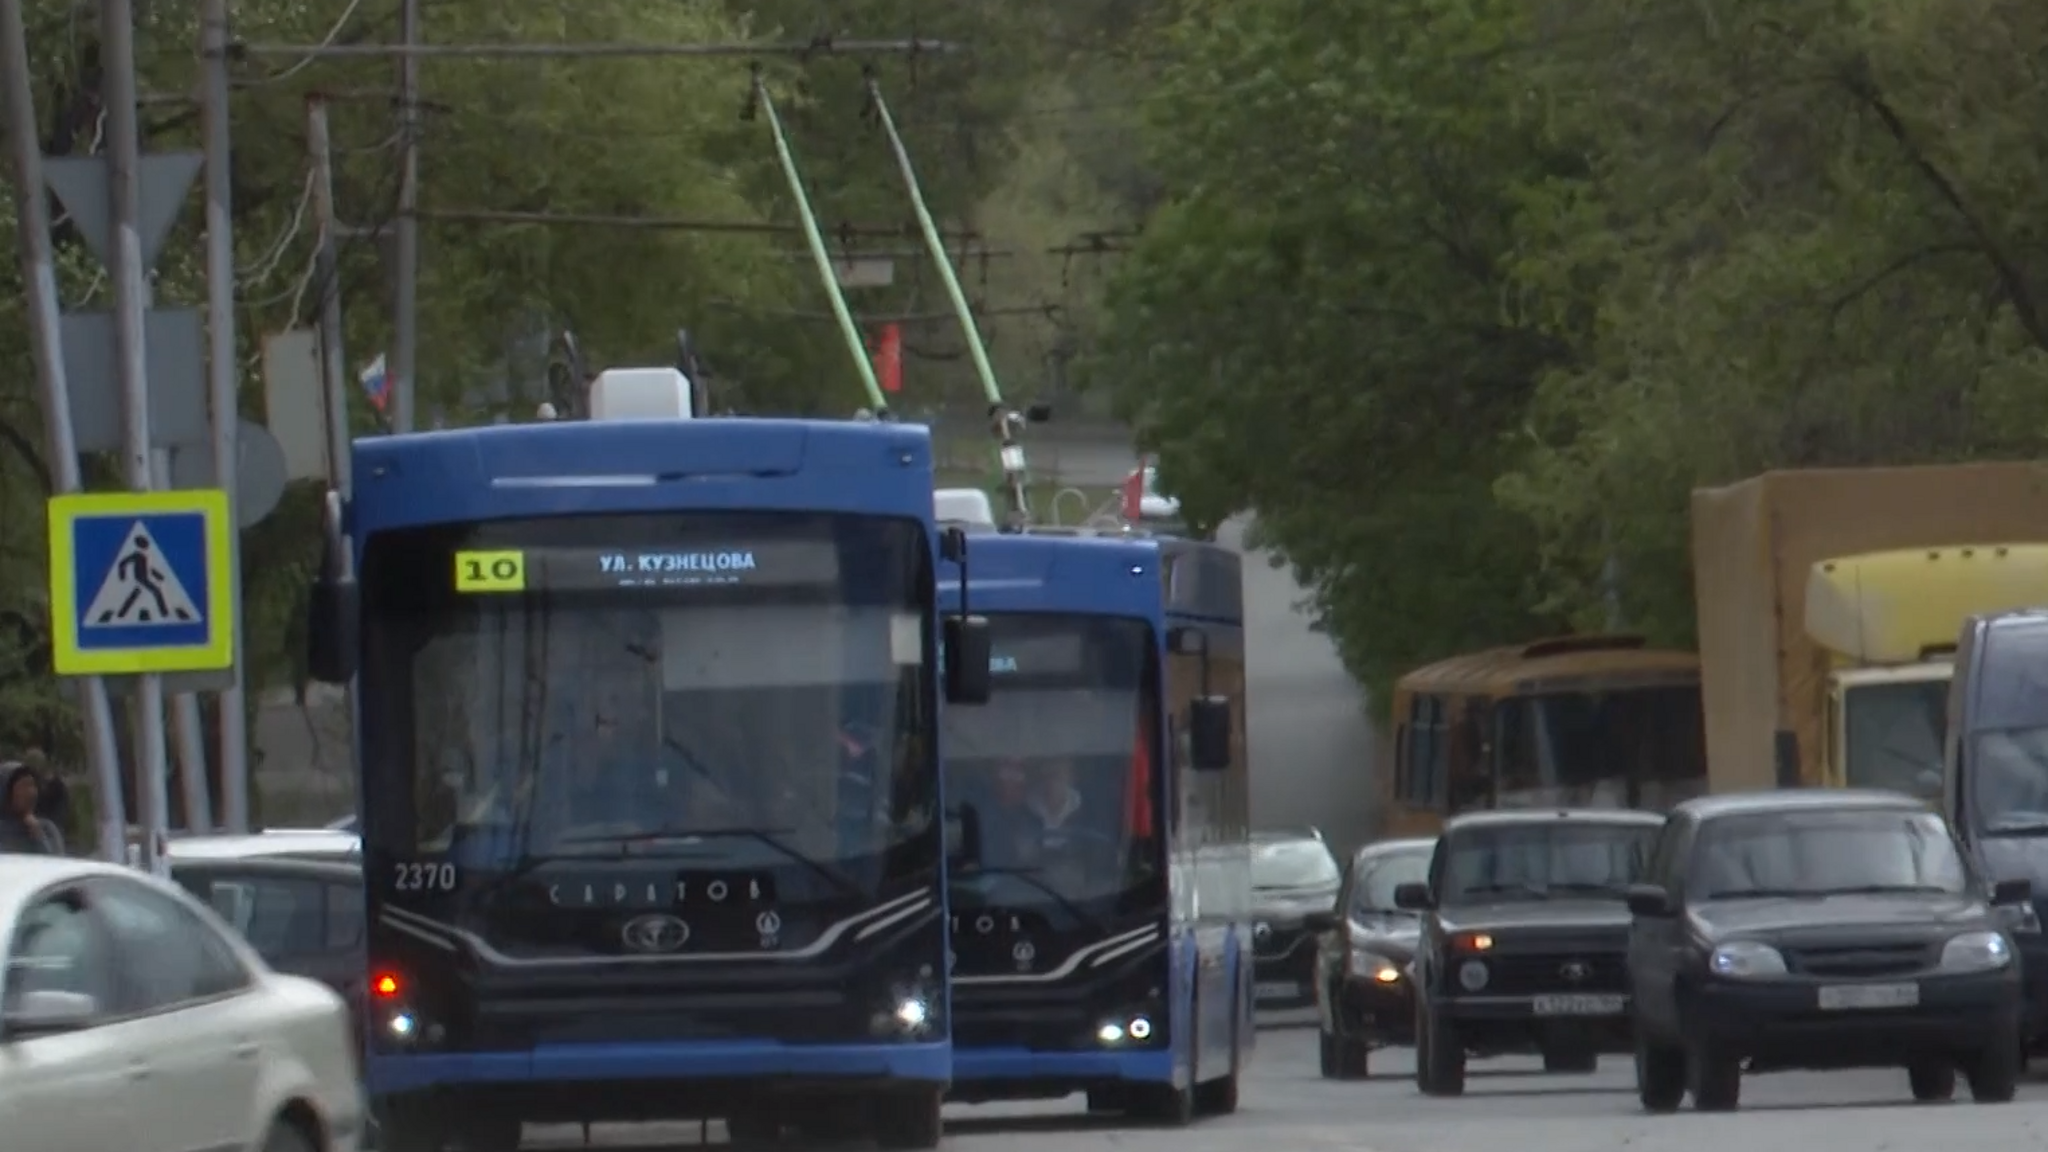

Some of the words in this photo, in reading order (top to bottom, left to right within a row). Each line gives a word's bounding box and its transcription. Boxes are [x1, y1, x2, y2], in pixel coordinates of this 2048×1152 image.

[465, 559, 518, 581] 10
[599, 555, 632, 573] УЛ.
[638, 551, 756, 573] КУЗНЕЦОВА
[394, 862, 456, 891] 2370
